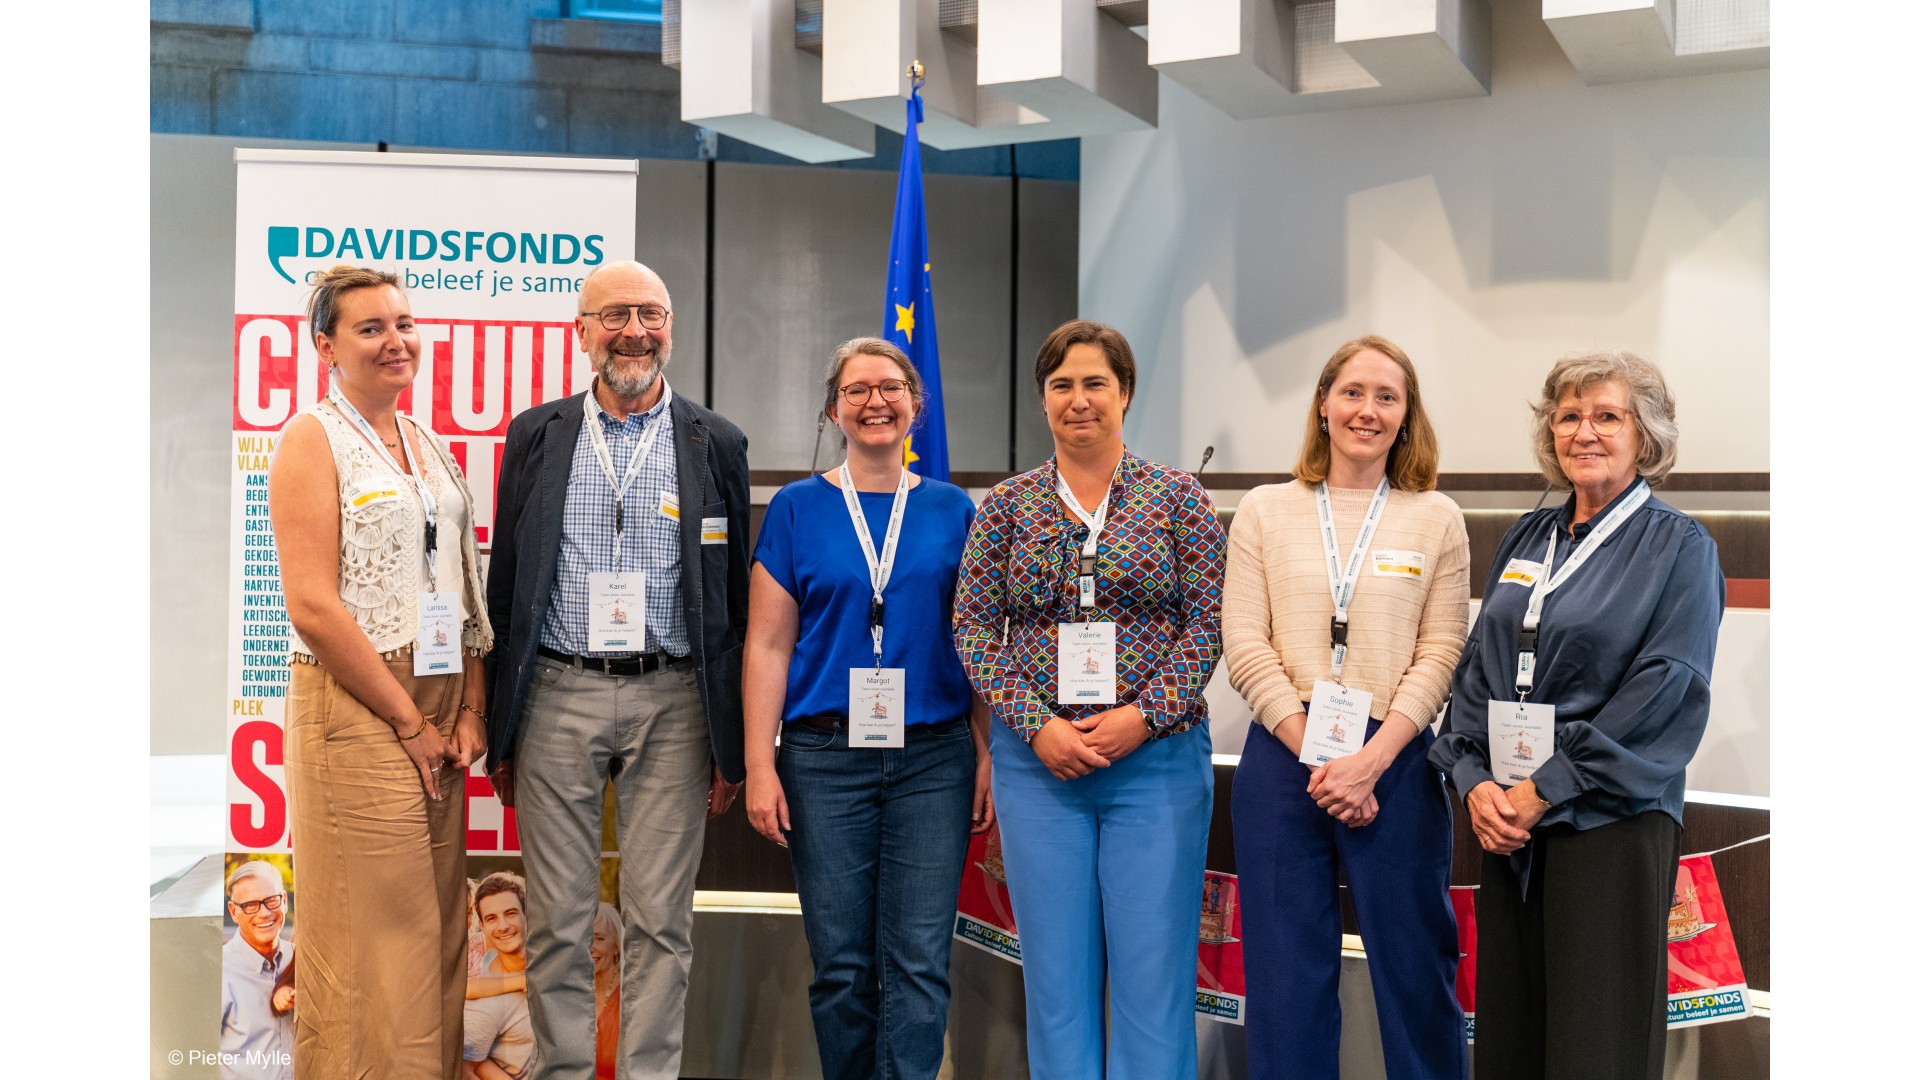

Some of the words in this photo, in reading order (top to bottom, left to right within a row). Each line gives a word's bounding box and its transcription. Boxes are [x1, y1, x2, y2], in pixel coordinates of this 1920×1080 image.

[305, 226, 605, 266] DAVIDSFONDS
[406, 268, 483, 291] beleef
[491, 270, 513, 297] je
[523, 274, 583, 293] same
[238, 437, 263, 453] WIJ
[238, 455, 269, 471] VLAA
[246, 490, 268, 501] BEGE
[245, 505, 269, 516] ENTH
[245, 535, 276, 546] GEDEE
[244, 565, 279, 576] GENERE
[244, 580, 282, 591] HARTVE
[244, 595, 285, 606] INVENTIE
[426, 604, 448, 612] Larissa
[243, 655, 289, 667] TOEKOMS
[866, 677, 890, 686] Margot
[1329, 695, 1354, 707] Sophie
[233, 700, 263, 715] PLEK
[1515, 713, 1528, 721] Ria
[1008, 949, 1022, 958] same
[1686, 1009, 1708, 1018] beleef
[1710, 1008, 1718, 1016] je
[1718, 1005, 1743, 1013] samen
